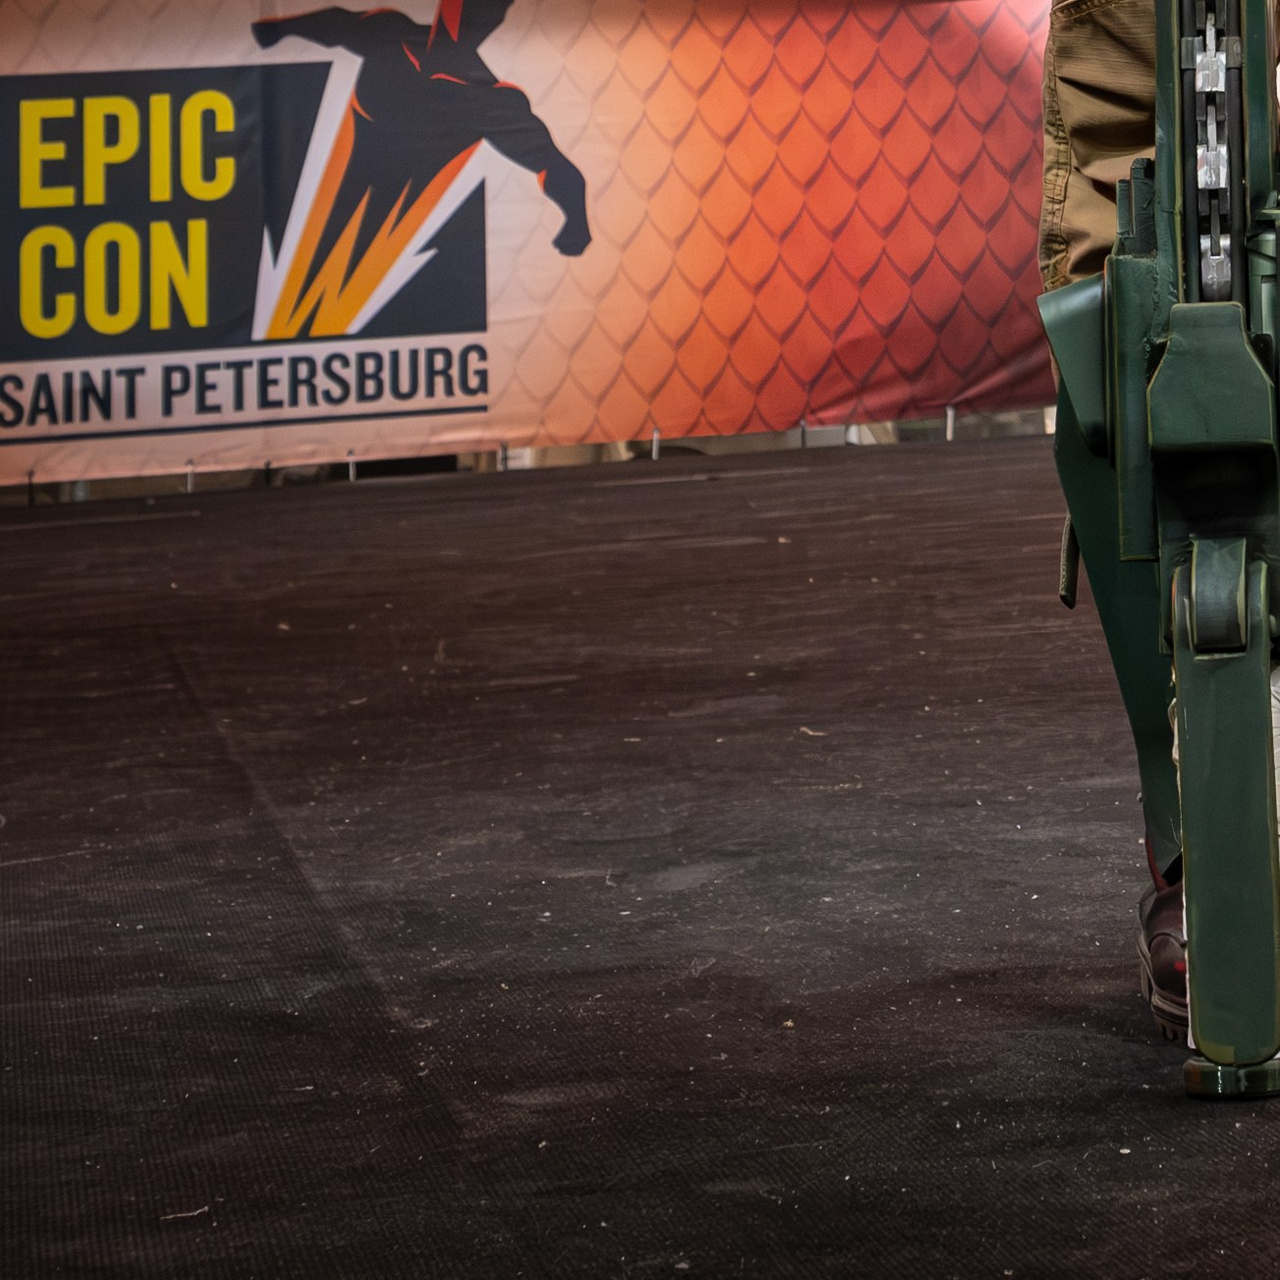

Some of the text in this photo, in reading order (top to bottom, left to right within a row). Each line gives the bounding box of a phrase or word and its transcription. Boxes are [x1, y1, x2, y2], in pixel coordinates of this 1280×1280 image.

[19, 89, 236, 209] EPIC
[19, 218, 209, 339] CON
[0, 343, 489, 429] SAINT PETERSBURG
